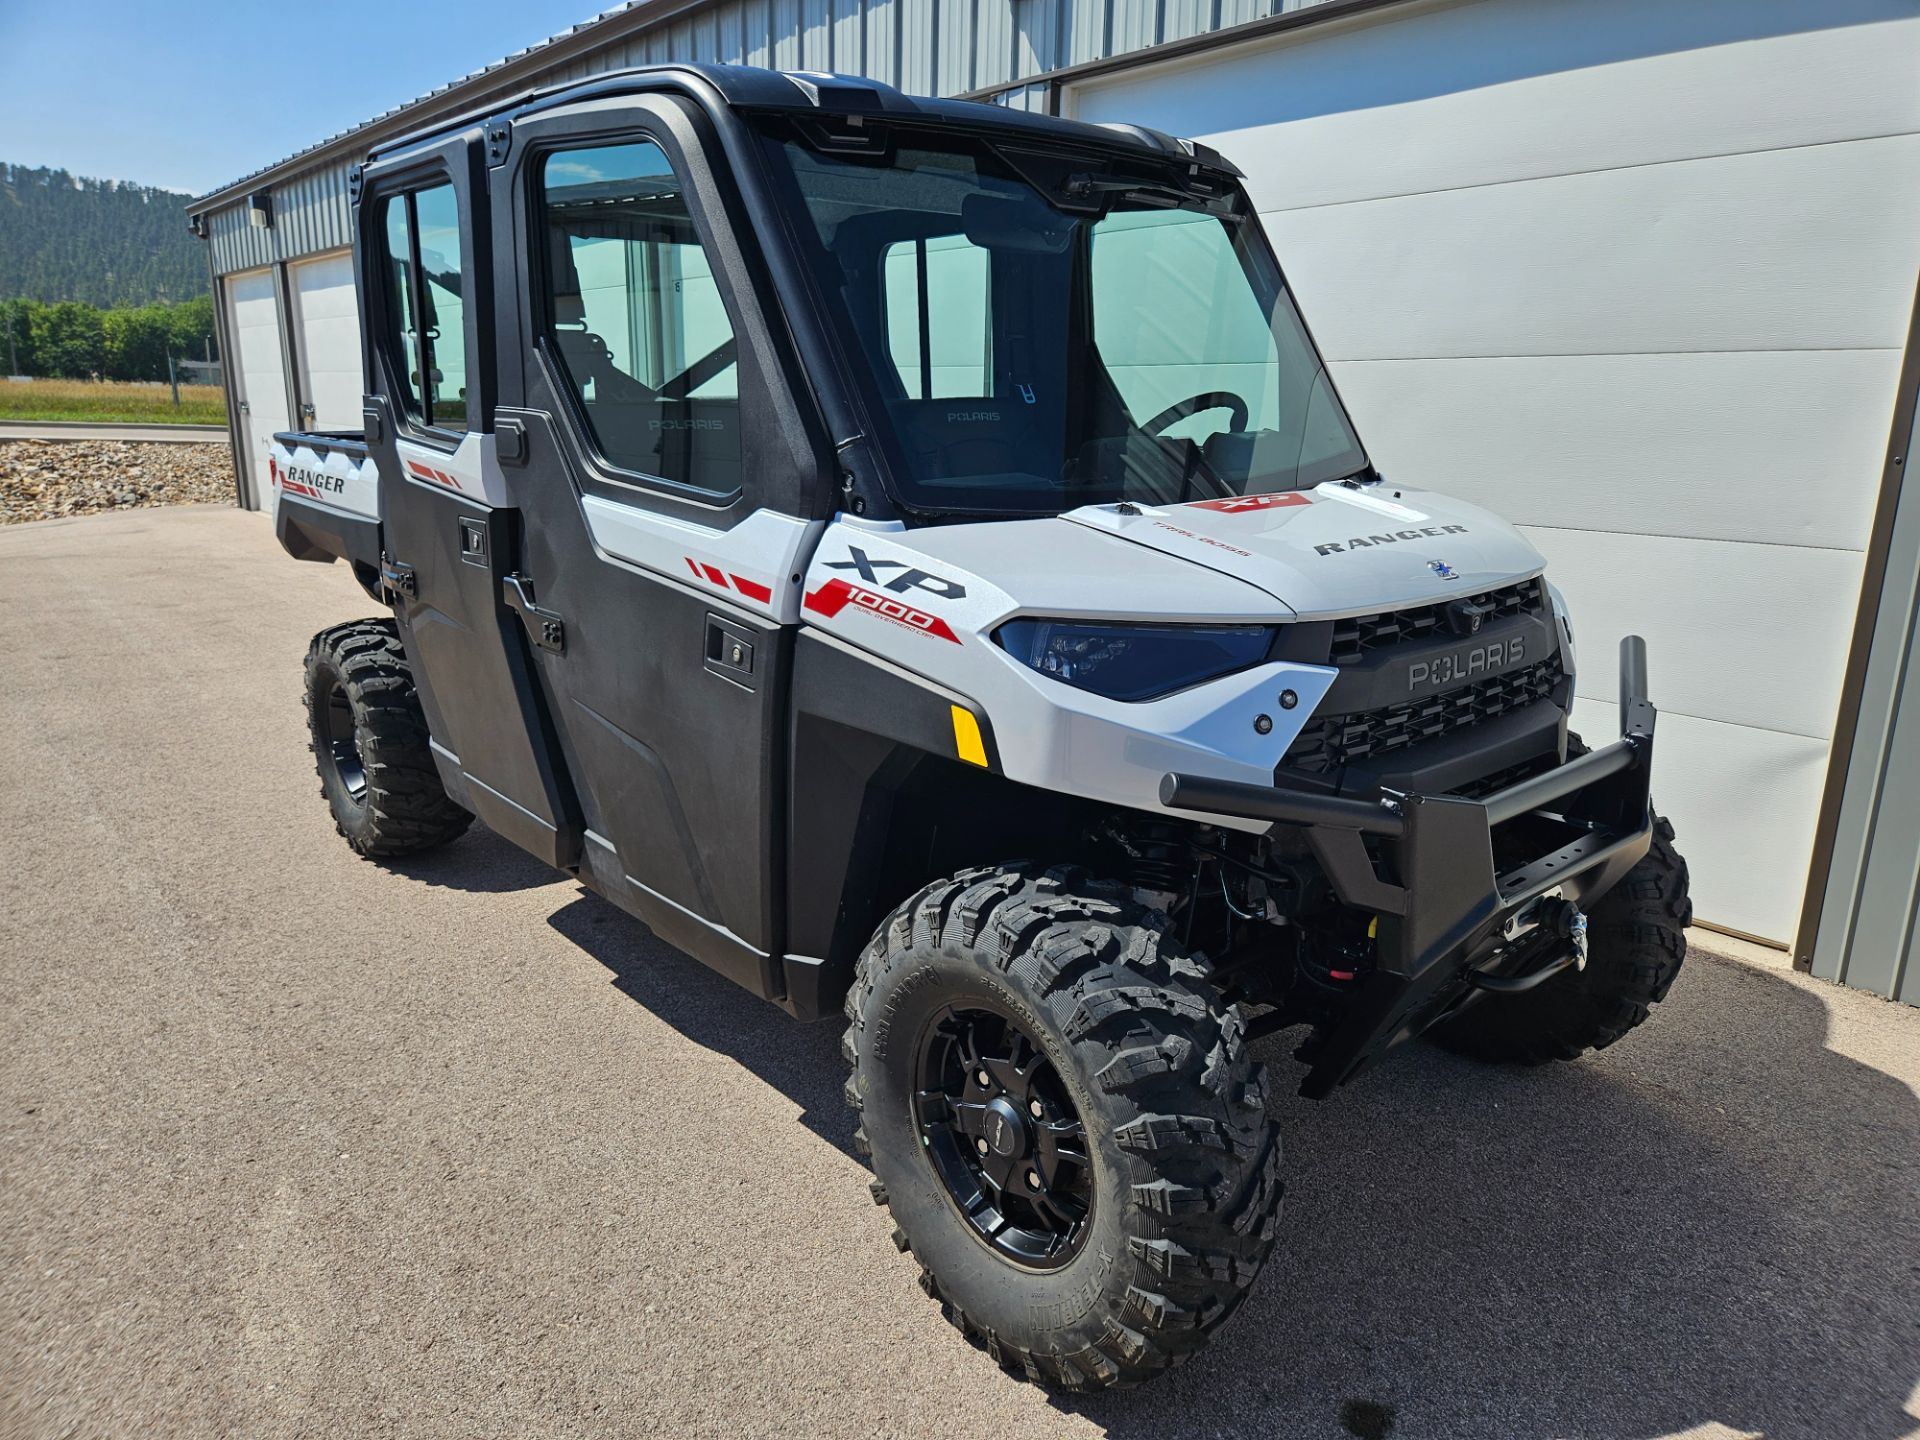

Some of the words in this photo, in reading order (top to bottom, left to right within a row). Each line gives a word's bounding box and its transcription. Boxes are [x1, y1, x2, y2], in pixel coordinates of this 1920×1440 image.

[648, 419, 724, 431] POLARIS
[947, 411, 1001, 422] POLARIS
[288, 466, 345, 494] RANGER
[1218, 494, 1291, 510] XP
[1313, 524, 1470, 557] RANGER
[821, 544, 966, 599] XP
[847, 587, 935, 629] 1000
[1409, 636, 1525, 691] POLARIS
